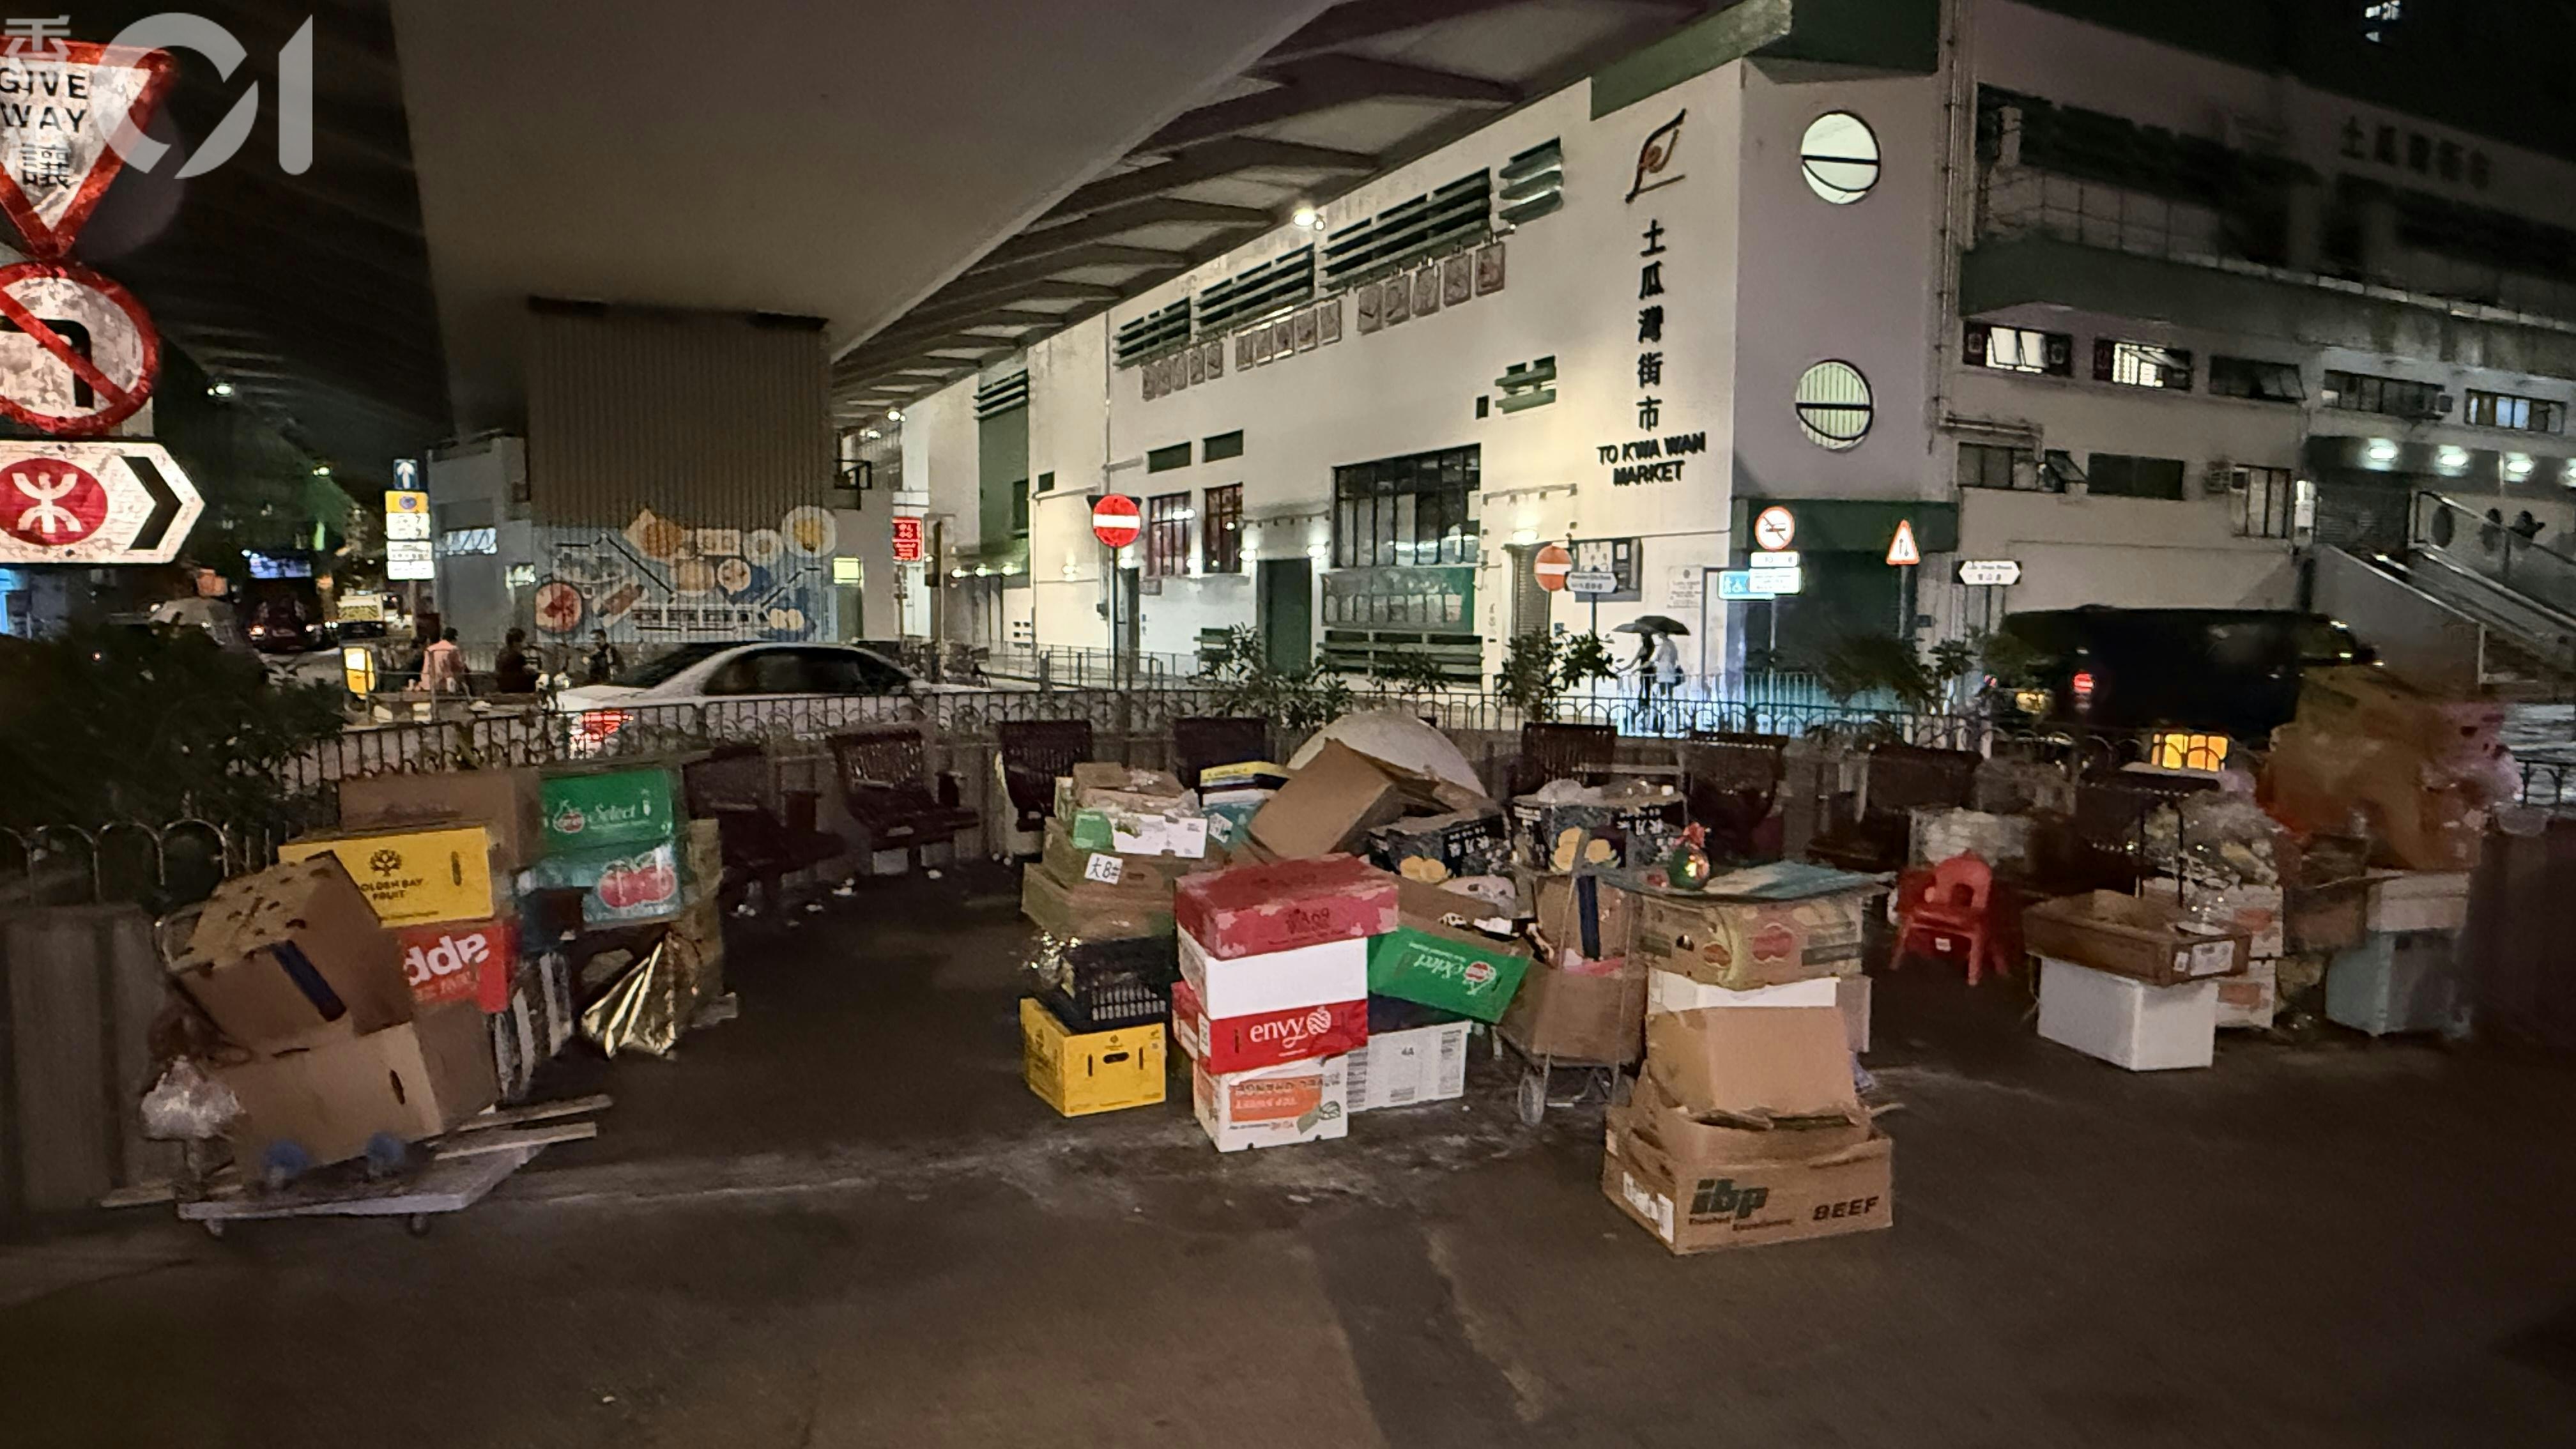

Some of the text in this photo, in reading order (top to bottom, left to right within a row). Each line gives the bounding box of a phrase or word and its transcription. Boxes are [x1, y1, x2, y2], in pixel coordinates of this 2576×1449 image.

[0, 68, 88, 99] GIVE
[0, 102, 86, 133] WAY
[1636, 218, 1666, 432] 土瓜灣街市
[1597, 431, 1706, 465] TO KWA WAN
[1613, 460, 1685, 486] MARKET
[360, 878, 424, 891] OLDEN BAY
[372, 890, 405, 900] FRUIT
[1250, 1016, 1308, 1048] envy
[1690, 1178, 1769, 1219] ibp
[1813, 1195, 1879, 1221] BEEF
